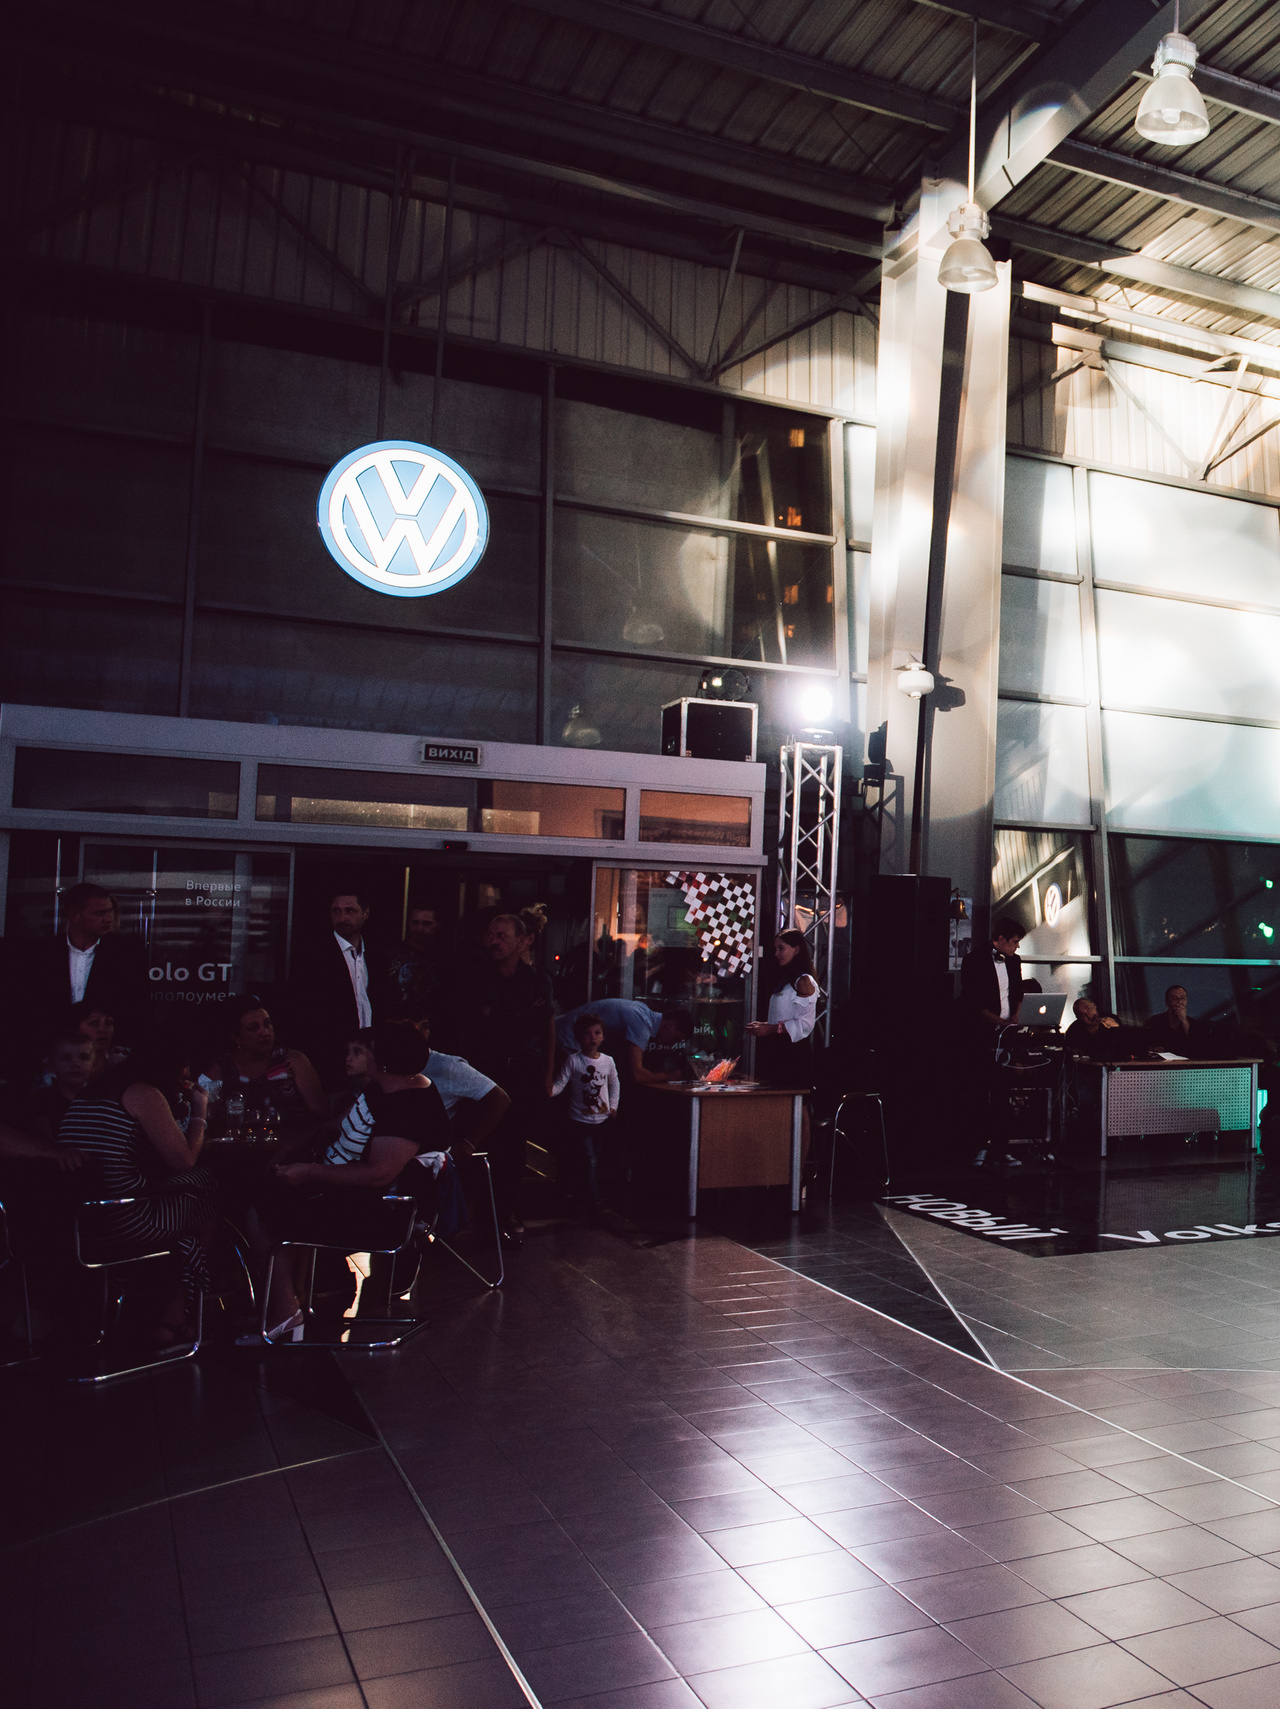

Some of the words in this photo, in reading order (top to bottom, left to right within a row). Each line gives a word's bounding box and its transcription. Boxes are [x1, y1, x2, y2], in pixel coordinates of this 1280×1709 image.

[428, 747, 474, 761] ВИХІД
[186, 880, 241, 893] Впервые
[185, 898, 192, 906] в
[196, 896, 241, 907] России
[149, 962, 190, 981] olo
[198, 963, 233, 981] GT
[151, 991, 236, 1005] полоуме
[881, 1193, 1070, 1241] НОВЫЙ
